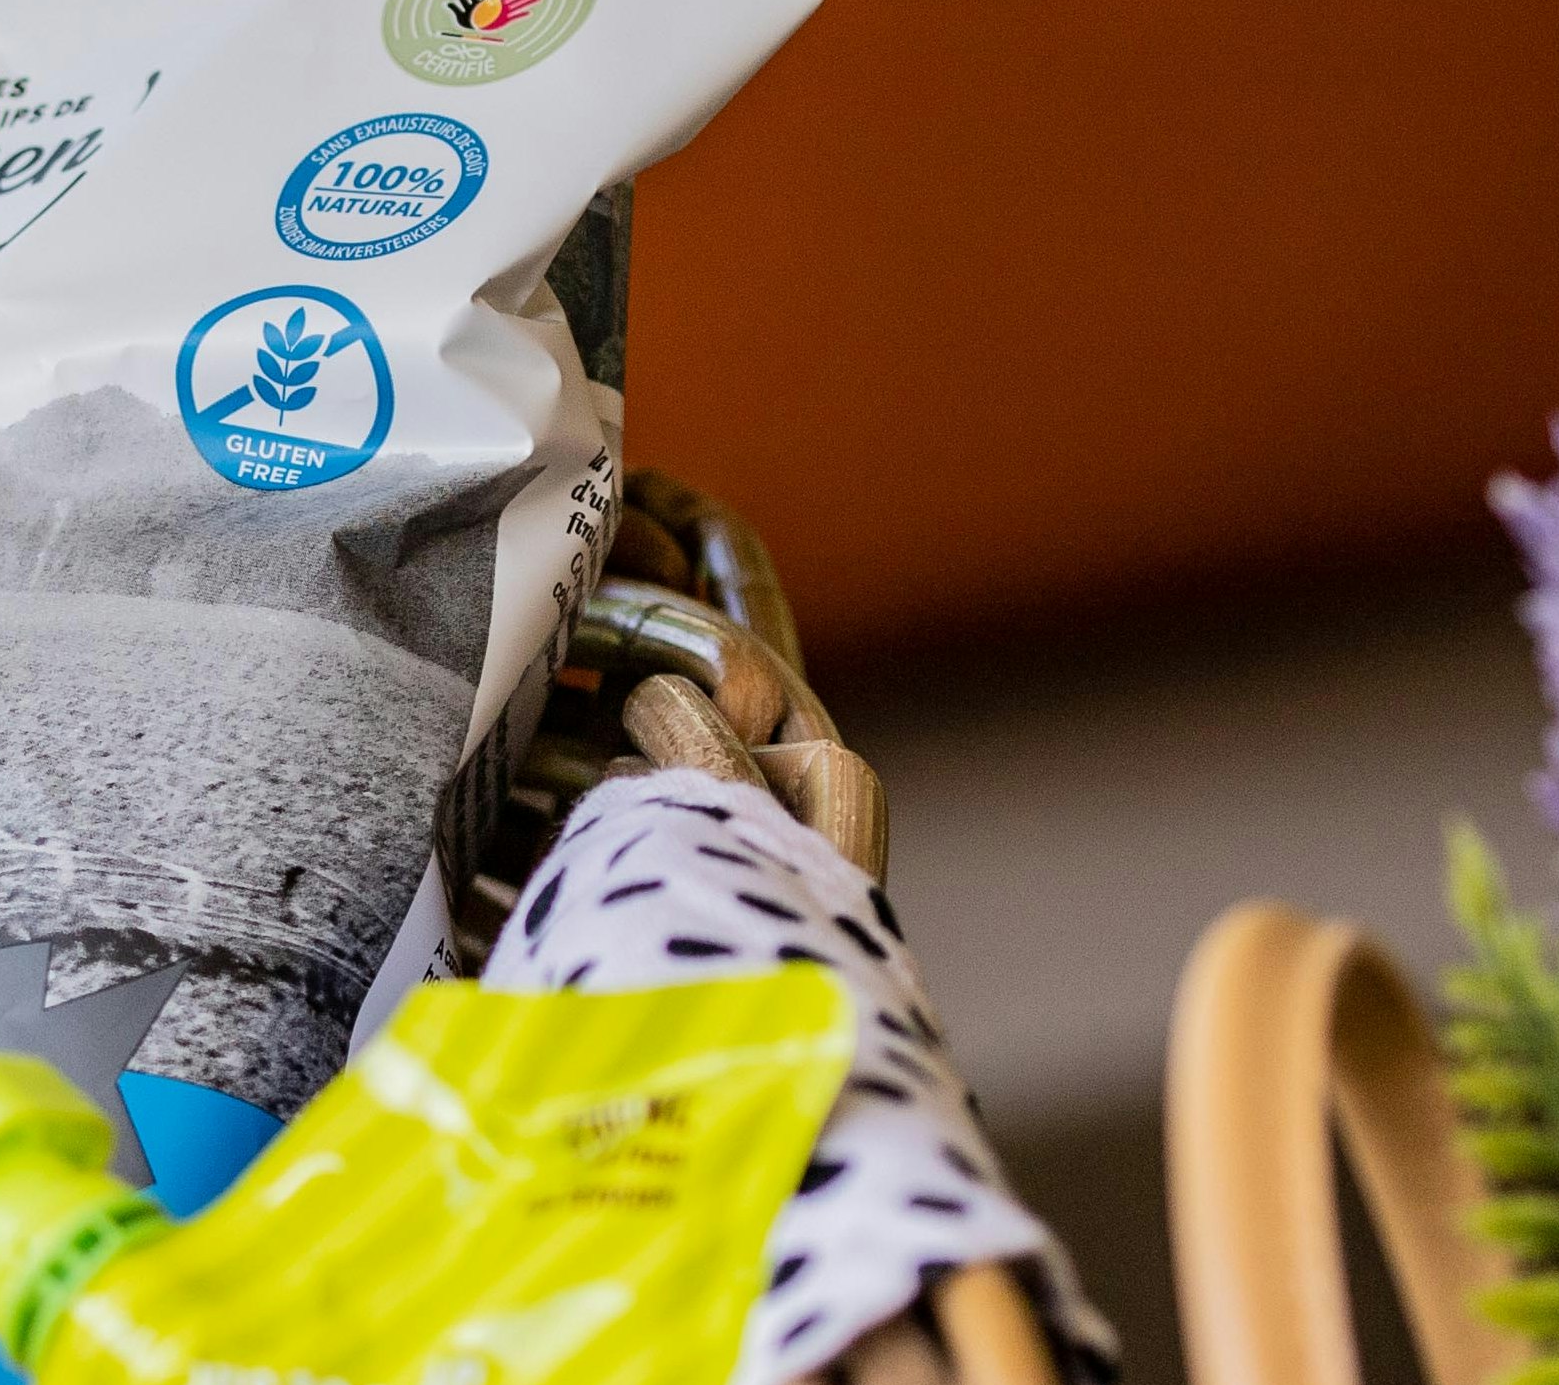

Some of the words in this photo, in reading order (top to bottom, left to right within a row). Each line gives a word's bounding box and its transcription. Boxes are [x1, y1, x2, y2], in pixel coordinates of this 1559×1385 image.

[54, 96, 93, 119] DE
[311, 134, 352, 165] SANS
[354, 116, 459, 142] EXHAUSTEURS
[453, 133, 475, 151] DE
[333, 161, 445, 193] 100%
[307, 196, 423, 217] NATURAL
[279, 204, 305, 244] ZONDER
[298, 214, 449, 259] SMAAKVERSTERKERS
[225, 434, 326, 469] GLUTEN
[238, 460, 303, 486] FREE
